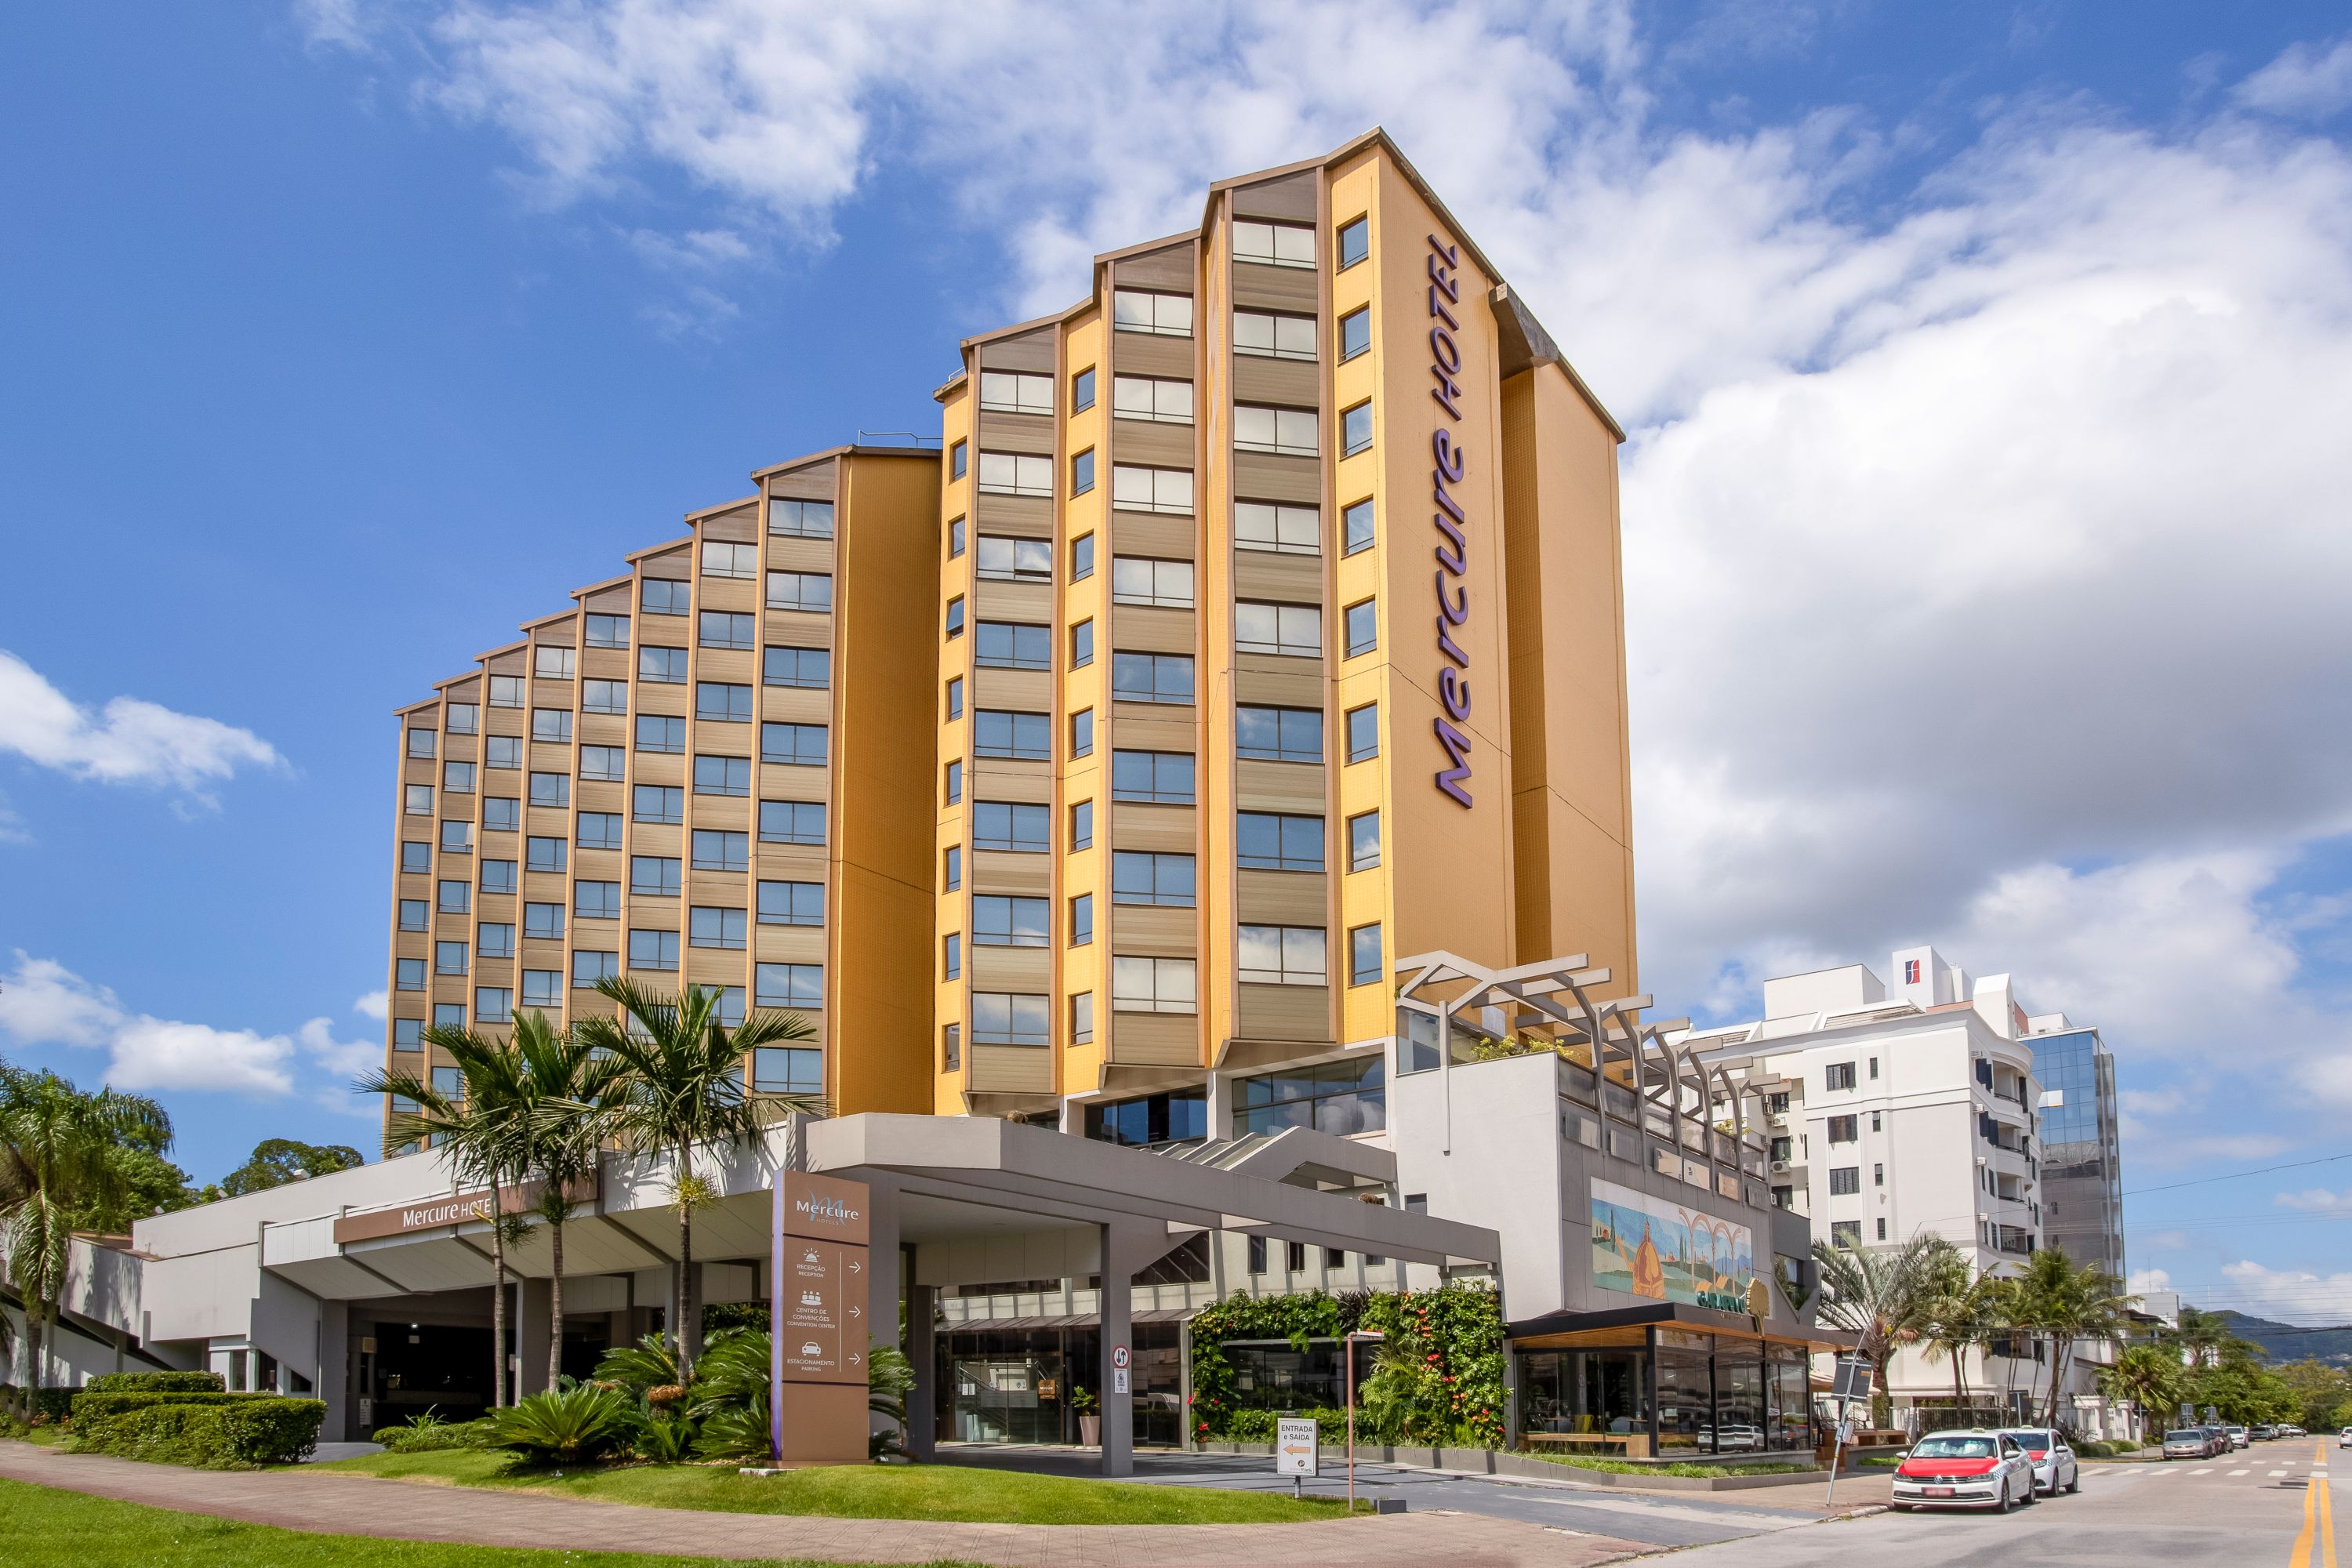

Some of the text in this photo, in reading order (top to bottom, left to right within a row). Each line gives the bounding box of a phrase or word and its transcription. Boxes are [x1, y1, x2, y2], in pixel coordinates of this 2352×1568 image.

[1428, 234, 1473, 810] Mercure HOTEL
[403, 1198, 492, 1228] Mercure HOTE
[797, 1200, 859, 1220] Mercure
[816, 1217, 840, 1226] HOTELS
[1289, 1432, 1310, 1441] SAÍDA
